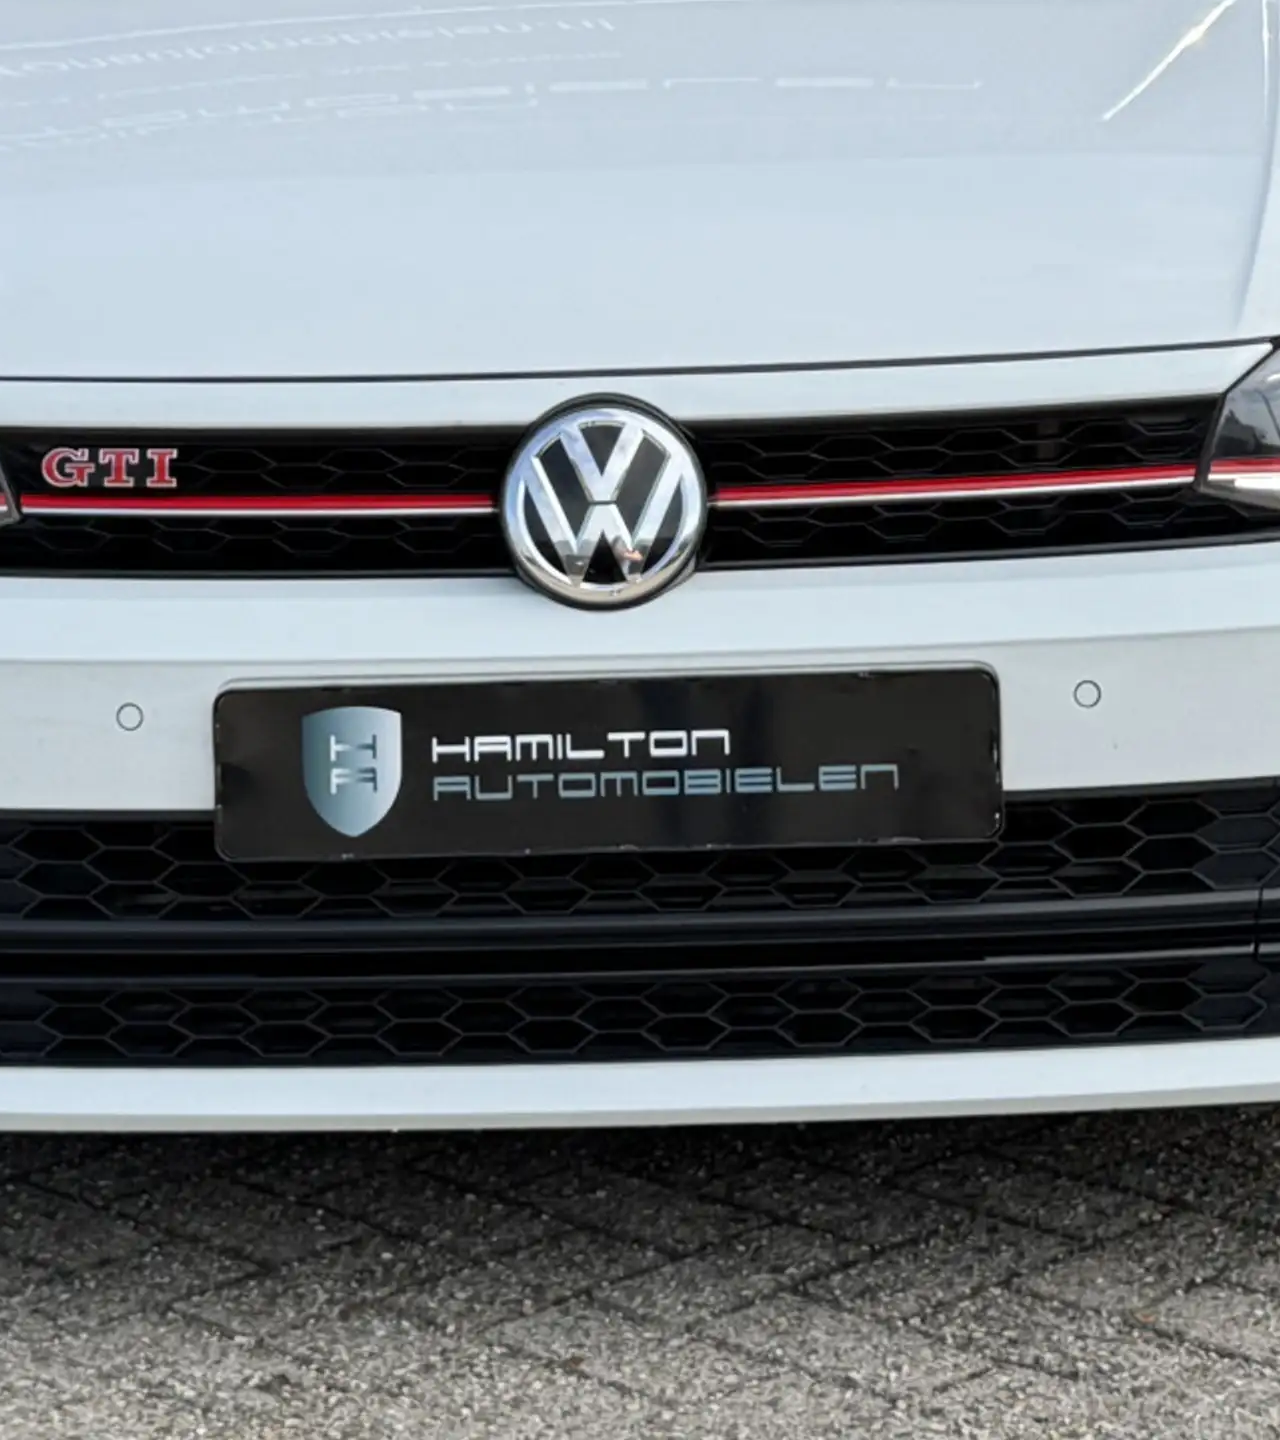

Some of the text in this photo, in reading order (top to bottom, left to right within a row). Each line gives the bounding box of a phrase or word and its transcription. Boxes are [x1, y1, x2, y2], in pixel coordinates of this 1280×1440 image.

[41, 447, 178, 488] GTI
[431, 729, 731, 763] HAMILTON
[431, 763, 899, 801] AUTOMOBIELEN
